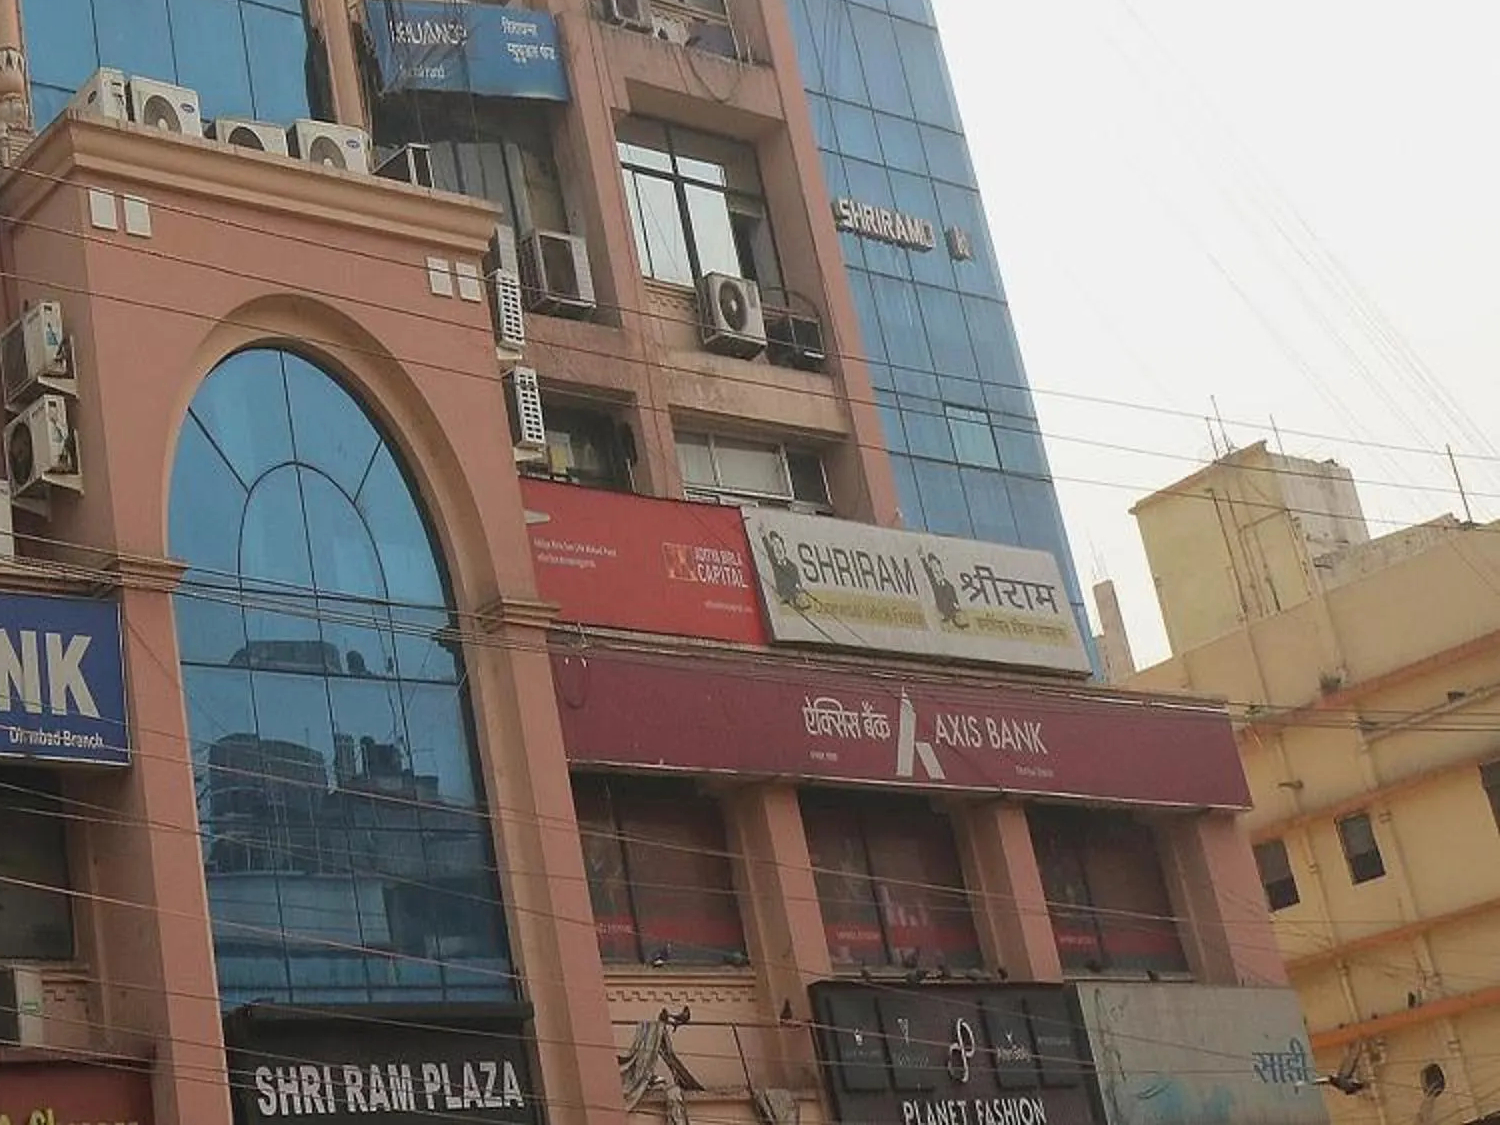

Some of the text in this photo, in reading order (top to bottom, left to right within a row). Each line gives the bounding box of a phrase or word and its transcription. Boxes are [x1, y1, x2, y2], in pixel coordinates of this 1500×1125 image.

[798, 543, 919, 596] SHRIRAM
[960, 565, 1060, 614] श्रीराम
[935, 714, 1048, 755] AXIS BANK
[255, 1060, 525, 1116] SHRI RAM PLAZA
[903, 1097, 1047, 1125] PLANET FASHION
